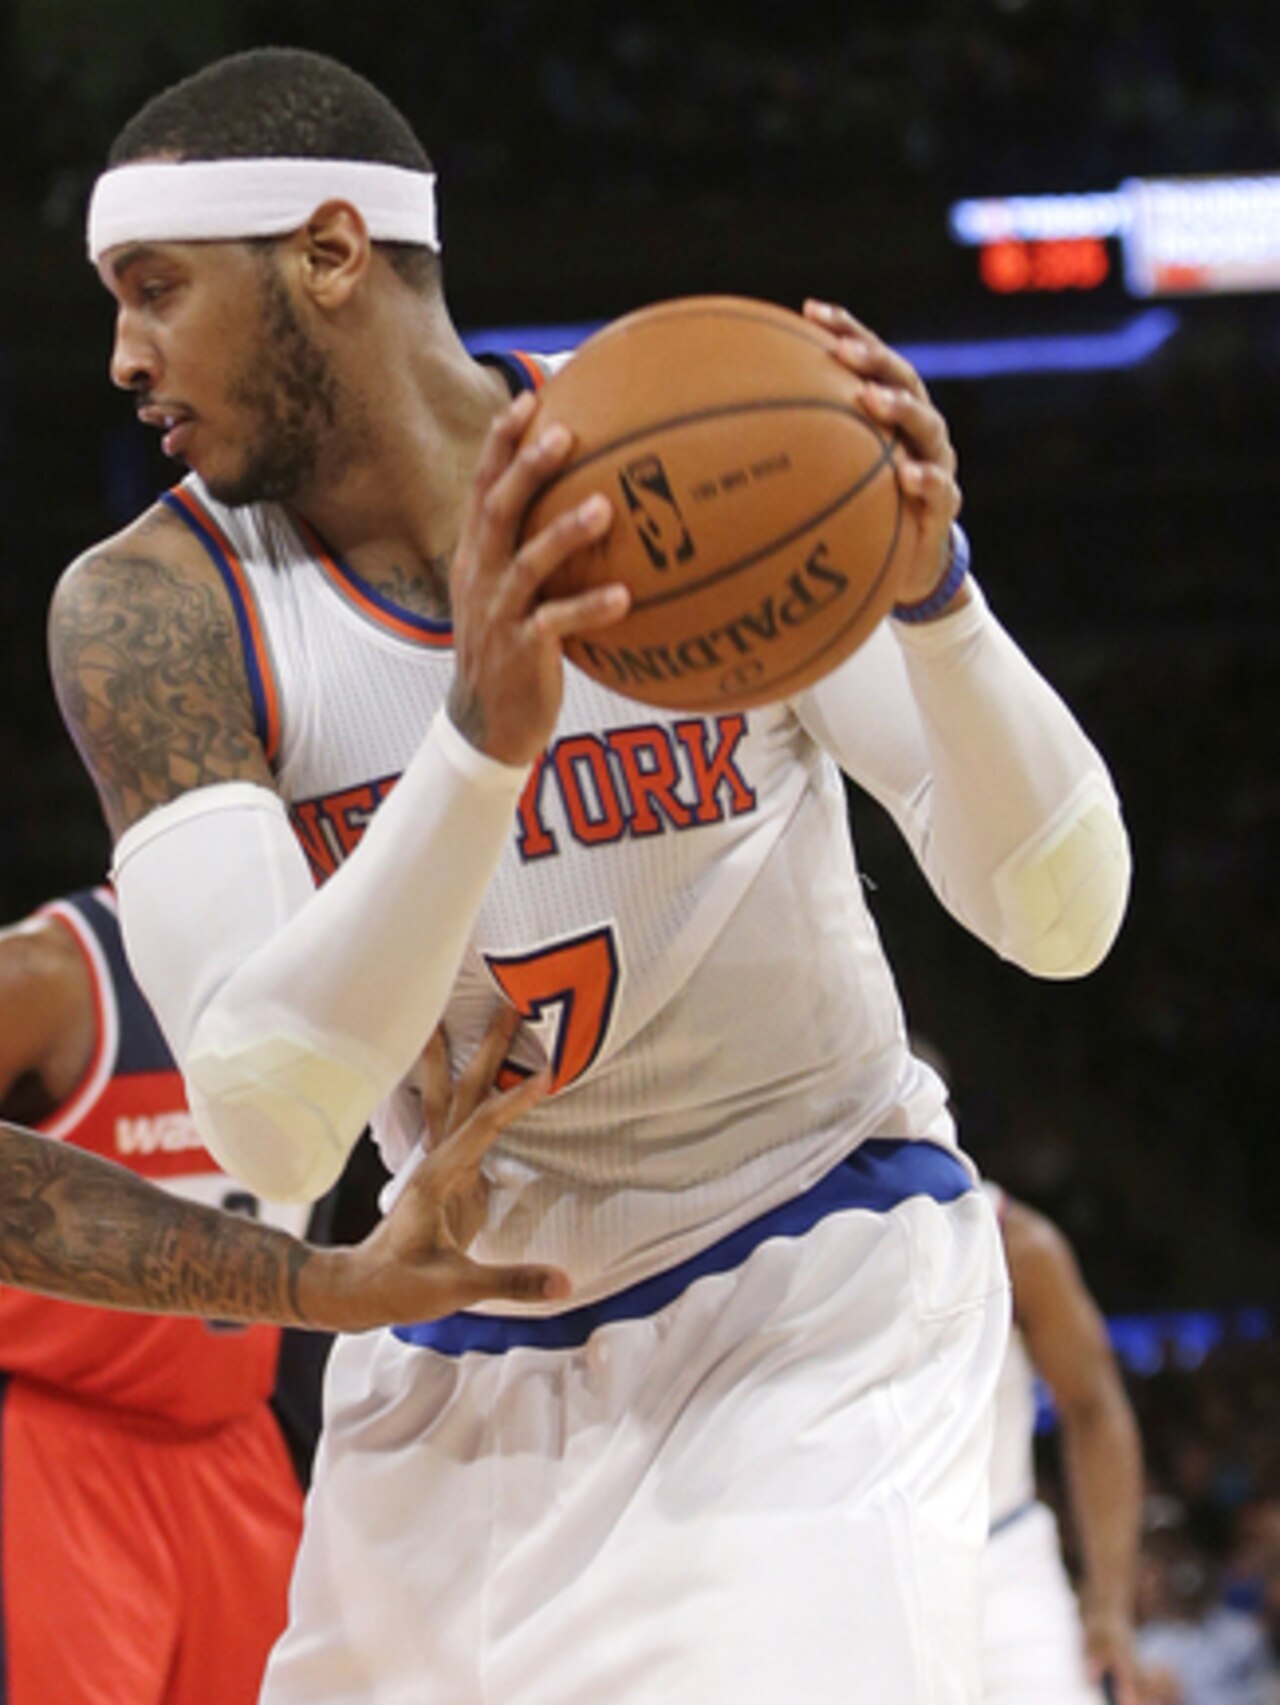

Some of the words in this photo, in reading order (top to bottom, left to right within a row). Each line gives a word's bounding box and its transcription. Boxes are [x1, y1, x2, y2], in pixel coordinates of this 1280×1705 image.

[582, 543, 850, 686] SPALDING
[517, 715, 756, 862] YORK
[483, 924, 620, 1096] 7
